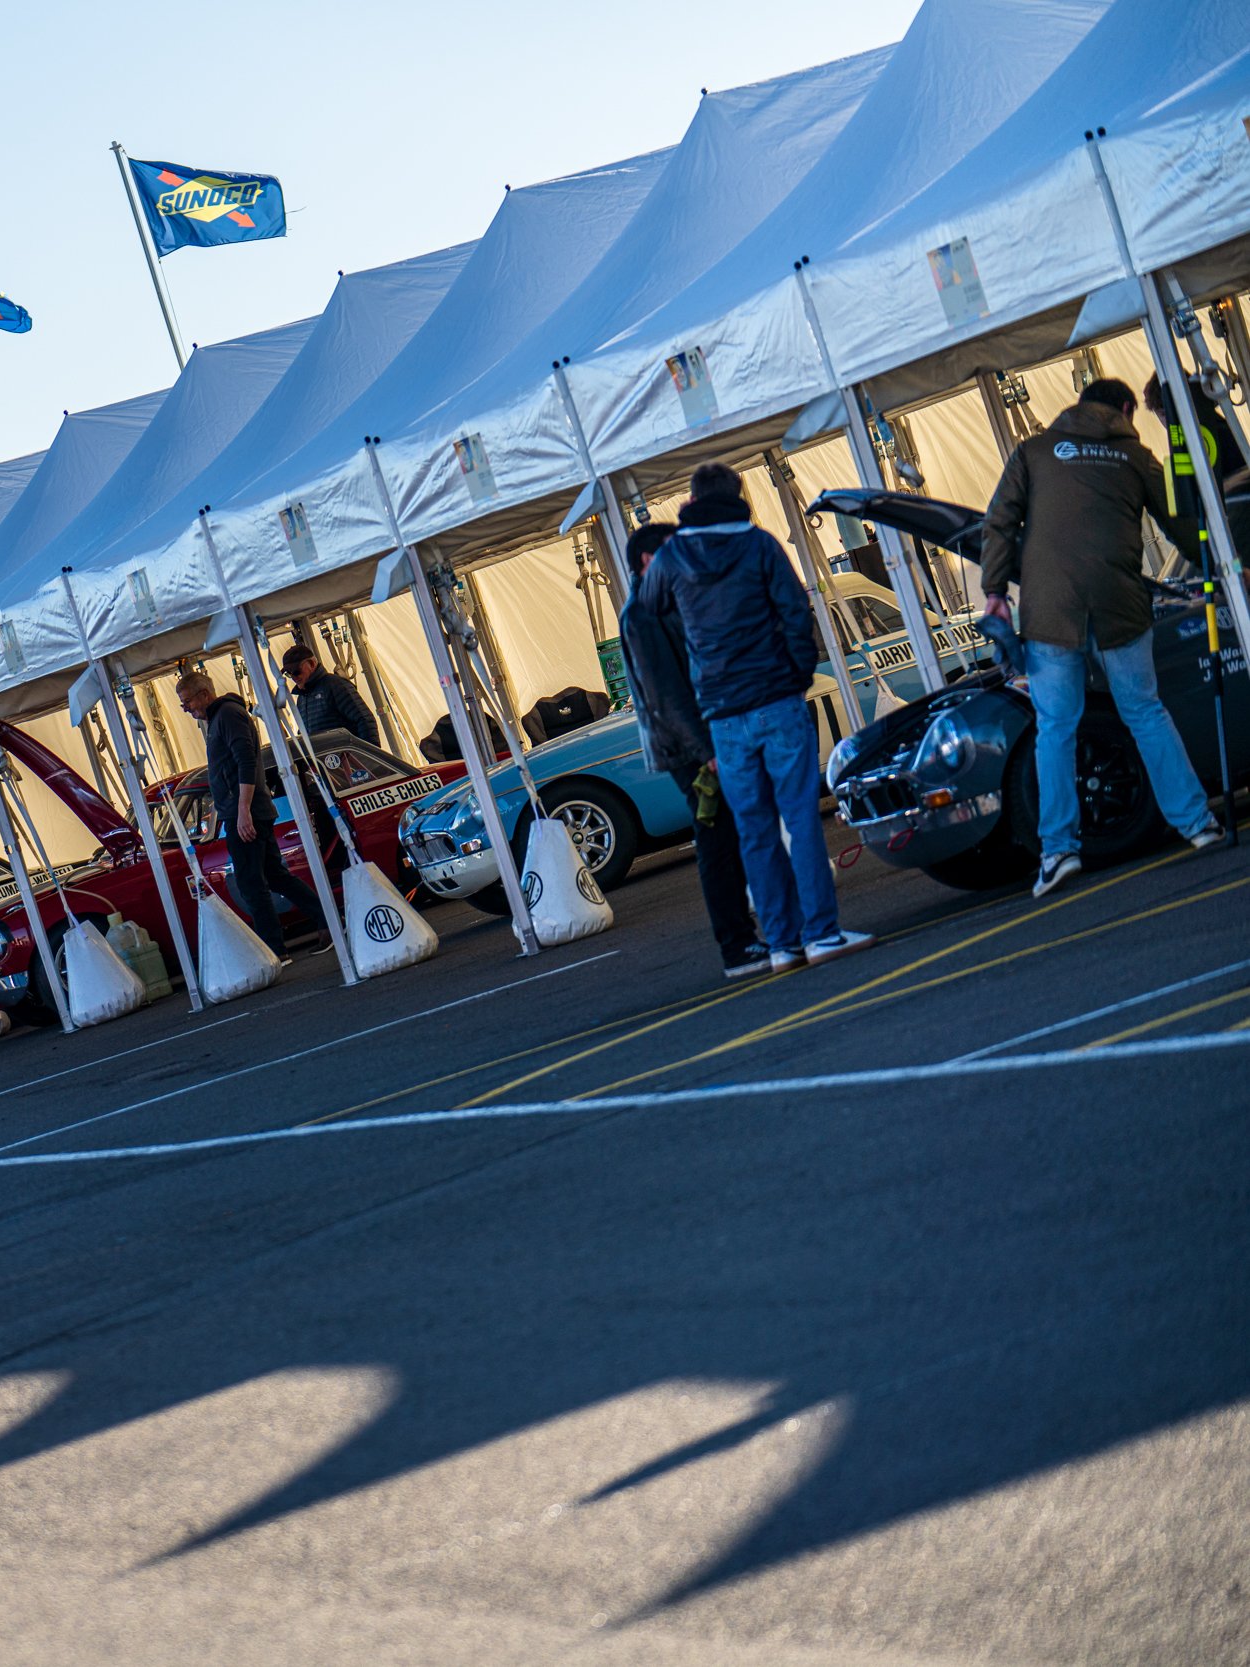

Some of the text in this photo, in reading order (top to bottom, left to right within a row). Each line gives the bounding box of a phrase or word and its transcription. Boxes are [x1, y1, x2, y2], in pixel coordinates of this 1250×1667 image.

[160, 183, 258, 214] SUNOCO
[1082, 448, 1128, 461] ENEVER
[350, 774, 442, 817] CHILES-CHILES
[367, 907, 401, 940] MRL
